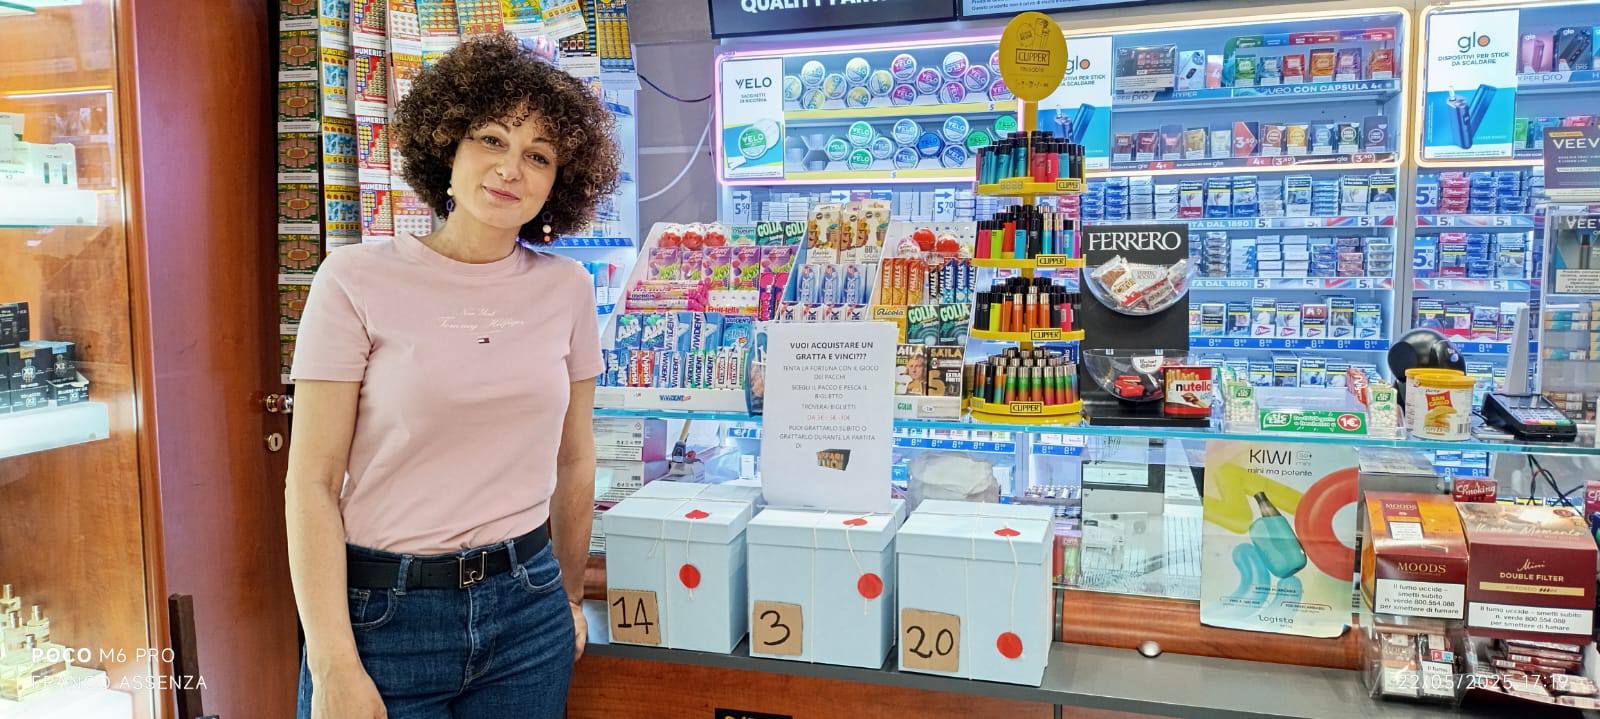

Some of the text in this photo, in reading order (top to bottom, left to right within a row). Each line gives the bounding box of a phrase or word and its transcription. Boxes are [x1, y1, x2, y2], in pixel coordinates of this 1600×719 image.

[1457, 32, 1490, 53] glo
[1018, 52, 1047, 63] CLIPPER
[736, 77, 772, 89] VELO
[1542, 73, 1563, 83] pro
[897, 89, 913, 98] VELO
[1294, 83, 1368, 93] CON CAPSULA
[853, 127, 869, 135] VELO
[948, 121, 966, 130] VELO
[743, 133, 764, 143] VELO
[1553, 138, 1600, 149] VEEV
[899, 154, 915, 162] VELO
[1207, 220, 1225, 228] DAL
[1227, 220, 1250, 228] 1890
[757, 222, 782, 238] GOLIA
[1088, 231, 1181, 251] FERRERO
[908, 306, 938, 323] GOLIA
[940, 305, 969, 322] GOLIA
[897, 346, 923, 357] AILA
[930, 349, 962, 358] SAILA
[1341, 417, 1359, 427] 1€
[1250, 449, 1291, 465] KIWI
[1456, 483, 1496, 497] Smoking
[1385, 503, 1417, 511] MOODS
[1398, 562, 1446, 574] MOODS
[1500, 572, 1564, 582] DOUBLE FILTER
[612, 597, 654, 634] 14
[1258, 615, 1294, 624] Logista
[760, 610, 790, 646] 3
[1545, 623, 1570, 631] fumare
[906, 625, 954, 659] 20
